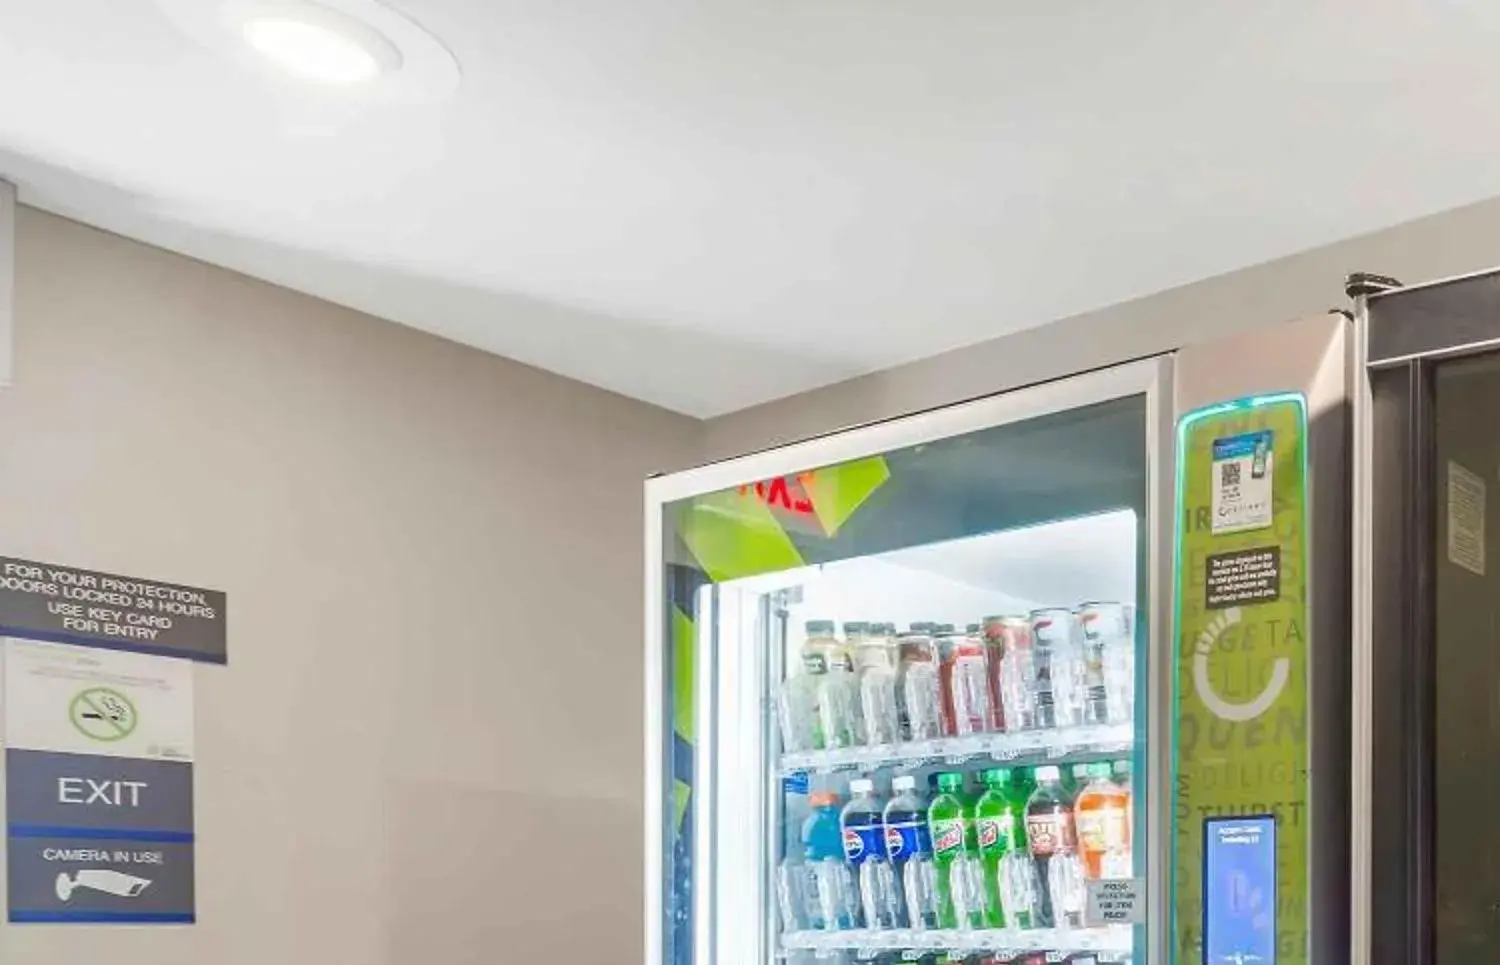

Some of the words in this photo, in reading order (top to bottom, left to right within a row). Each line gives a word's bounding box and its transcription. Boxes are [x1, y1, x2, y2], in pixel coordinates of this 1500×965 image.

[4, 563, 43, 581] FOR
[47, 569, 97, 589] YOUR
[48, 601, 83, 617] USE
[88, 607, 122, 622] KEY
[126, 612, 172, 630] CARD
[63, 584, 132, 607] LOCKED
[136, 597, 154, 609] 24
[158, 601, 216, 620] HOURS
[63, 617, 99, 632] FOR
[104, 621, 158, 640] ENTRY
[57, 776, 149, 808] EXIT
[42, 846, 110, 864] CAMERA
[113, 850, 129, 863] IN
[132, 850, 165, 865] USE
